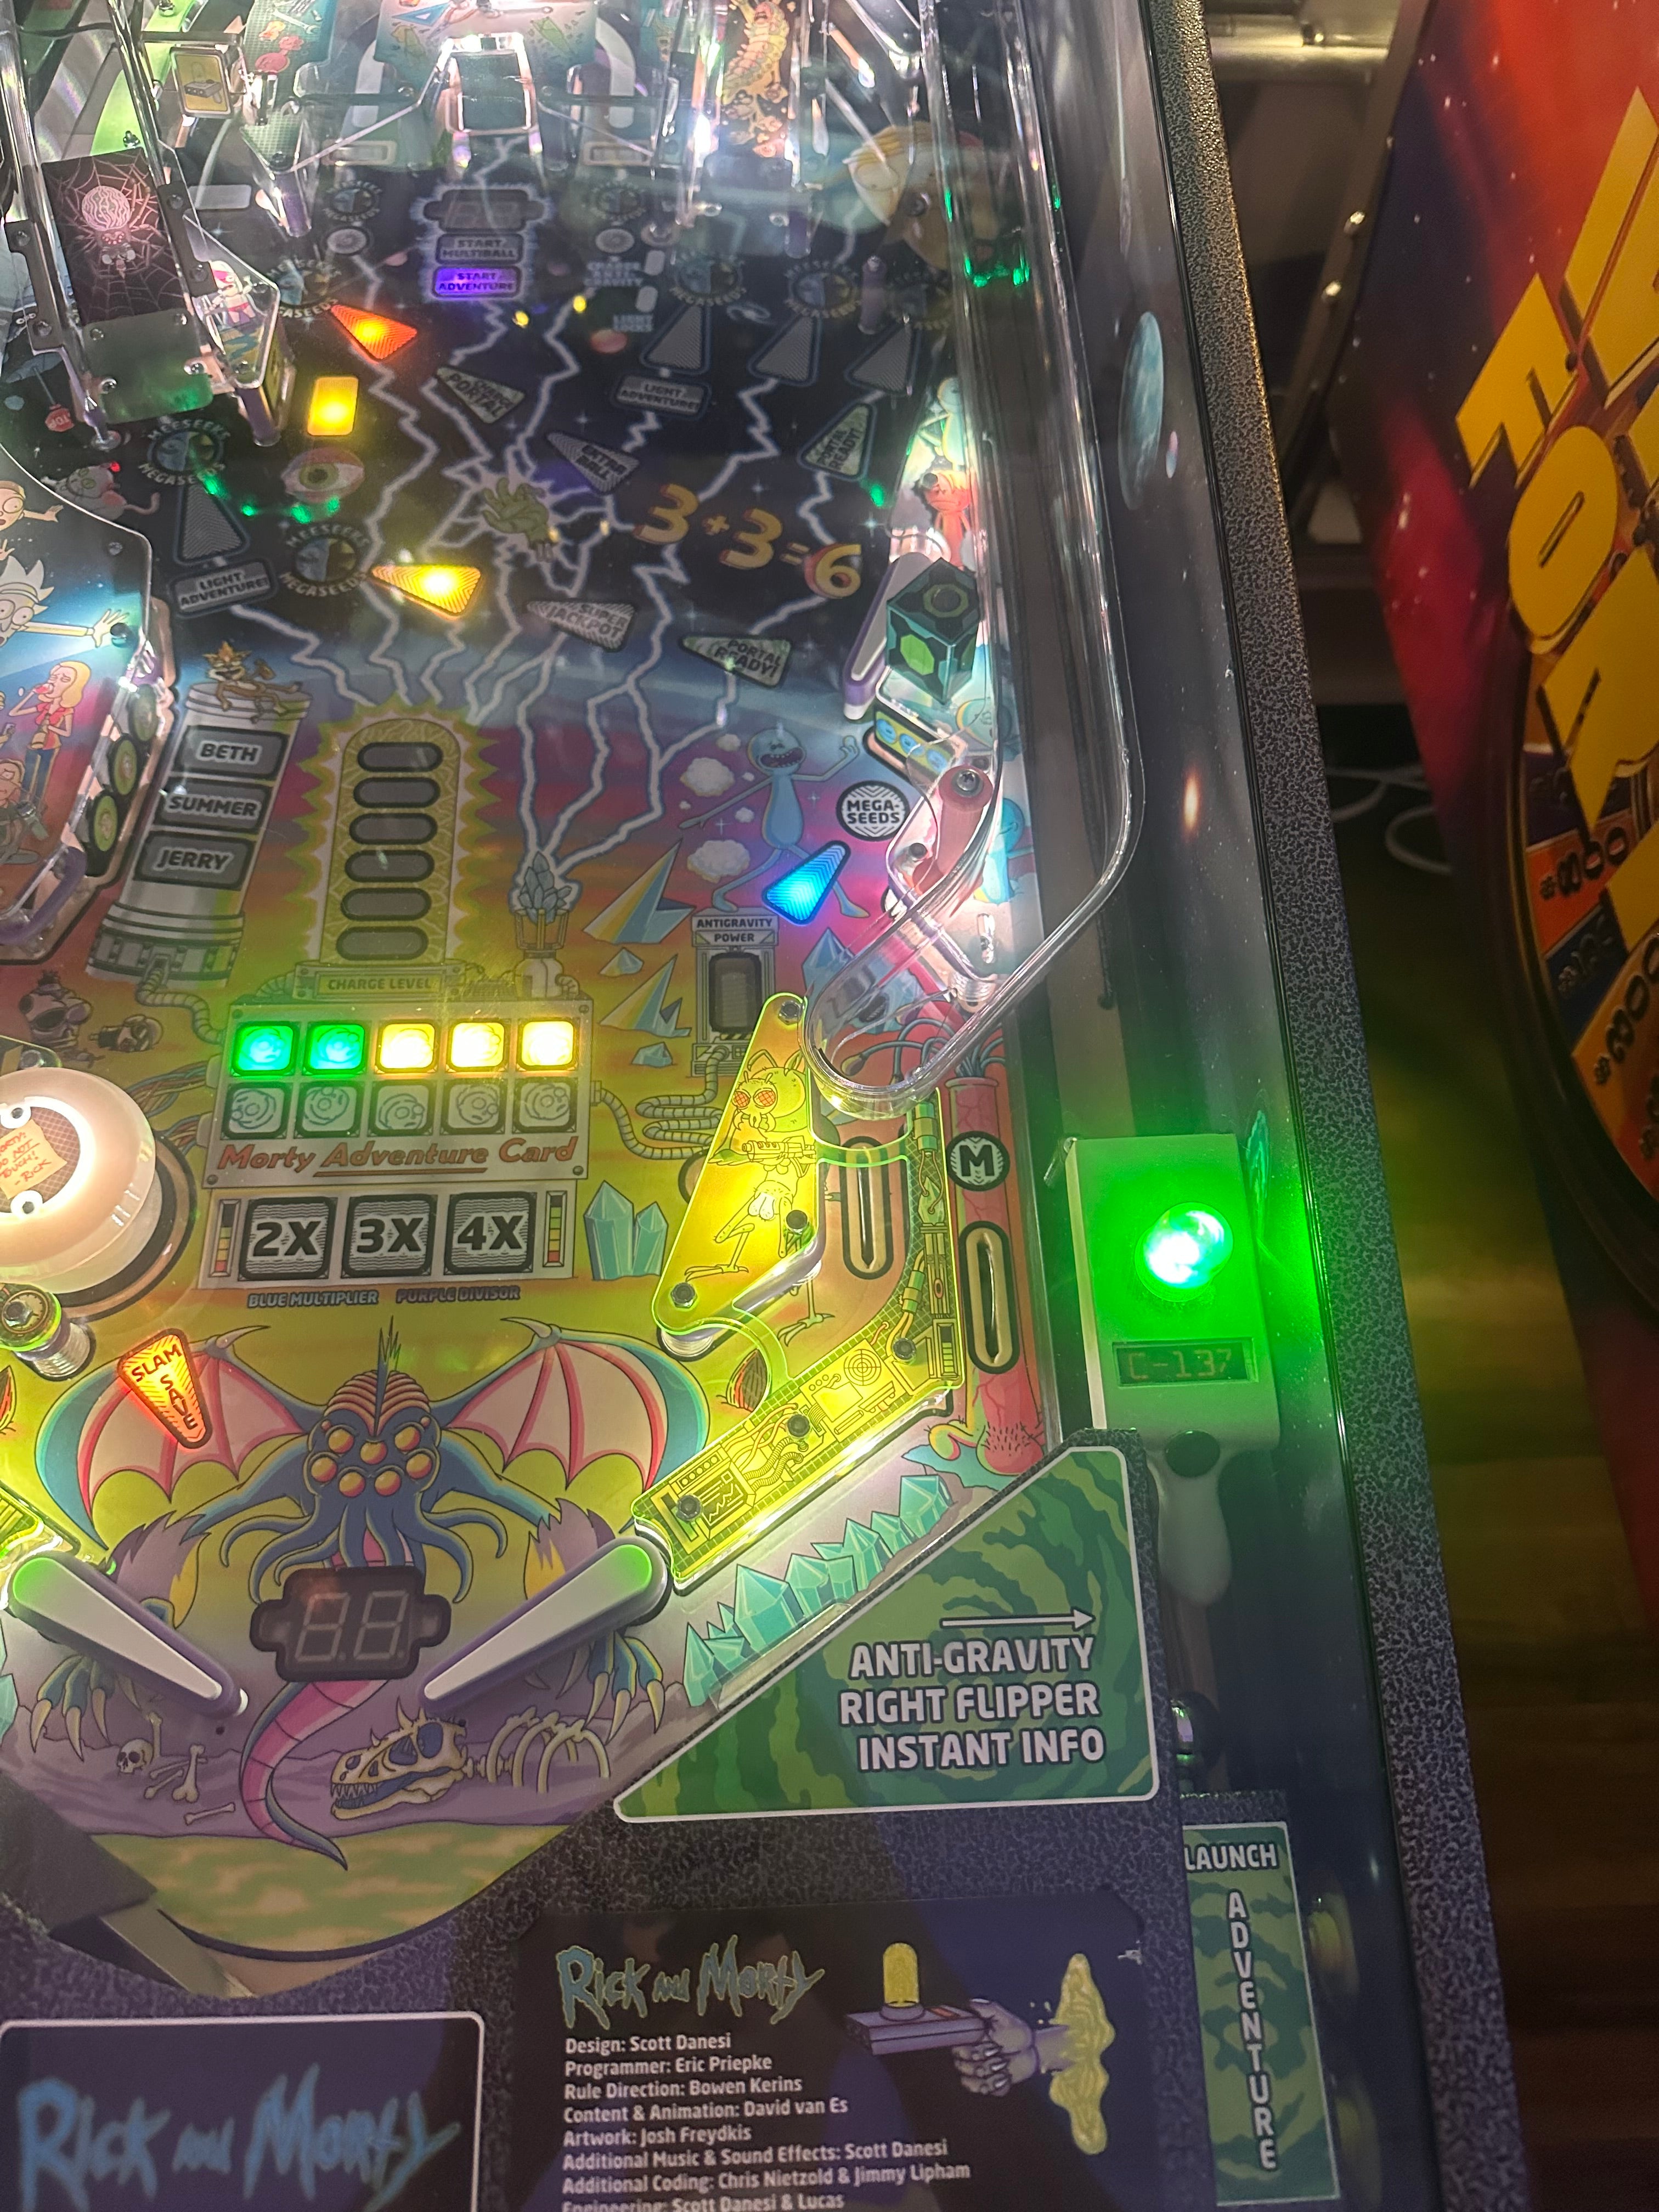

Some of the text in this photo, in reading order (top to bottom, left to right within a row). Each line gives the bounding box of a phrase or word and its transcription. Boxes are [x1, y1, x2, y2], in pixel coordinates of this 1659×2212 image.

[458, 238, 503, 248] START
[439, 282, 515, 291] ADVENTURE
[458, 272, 497, 280] START
[200, 572, 241, 591] LIGHT
[578, 603, 628, 628] SUPER
[715, 646, 779, 678] READY!
[728, 639, 781, 667] PORTAL
[201, 743, 258, 762] BETH
[168, 795, 257, 817] SUMMER
[847, 799, 900, 812] MEGA-
[847, 812, 900, 824] SEEDS
[157, 850, 229, 871] JERRY
[696, 918, 773, 928] ANTIGRAVITY
[714, 933, 755, 943] POWER
[328, 978, 430, 990] CHARGE LEVEL
[218, 1136, 578, 1173] Morty Adventure Card
[959, 1144, 995, 1176] M
[253, 1221, 321, 1256] 2X
[359, 1217, 424, 1253] 3X
[458, 1216, 522, 1251] 4X
[248, 1290, 380, 1308] BLUE MULTIPLIER
[396, 1286, 521, 1304] PURPLE DIVISOR
[132, 1344, 182, 1382] SLAM
[1128, 1348, 1231, 1380] C-137
[160, 1374, 198, 1430] SAVE
[850, 1637, 1094, 1678] ANTI-GRAVITY
[839, 1683, 1100, 1725] RIGHT FLIPPER
[859, 1728, 1104, 1770] INSTANT INFO
[1184, 1844, 1277, 1871] LAUNCH
[556, 1945, 651, 2030] Rick
[697, 1934, 825, 2024] Morty
[1228, 1891, 1276, 2170] ADVENTURE
[566, 2032, 731, 2056] Design: Scott Danesi
[565, 2055, 772, 2079] Programmer: Eric Priepke
[564, 2076, 803, 2100] Rule Direction: Bowen Kerins
[563, 2097, 849, 2123] Content & Animation: David van Es
[563, 2129, 636, 2147] Artwork:
[640, 2127, 676, 2148] Josh
[562, 2138, 948, 2171] Additional Music & Sound Effects: Scott Danesi
[562, 2175, 648, 2194] Additional
[652, 2173, 714, 2193] Coding:
[718, 2171, 759, 2189] Chris
[837, 2166, 850, 2184] &
[854, 2165, 906, 2187] Jimmy
[910, 2162, 970, 2183] Lipham
[672, 2198, 714, 2212] Scott
[719, 2194, 776, 2212] Danesi
[781, 2193, 793, 2210] &
[798, 2192, 845, 2210] Lucas
